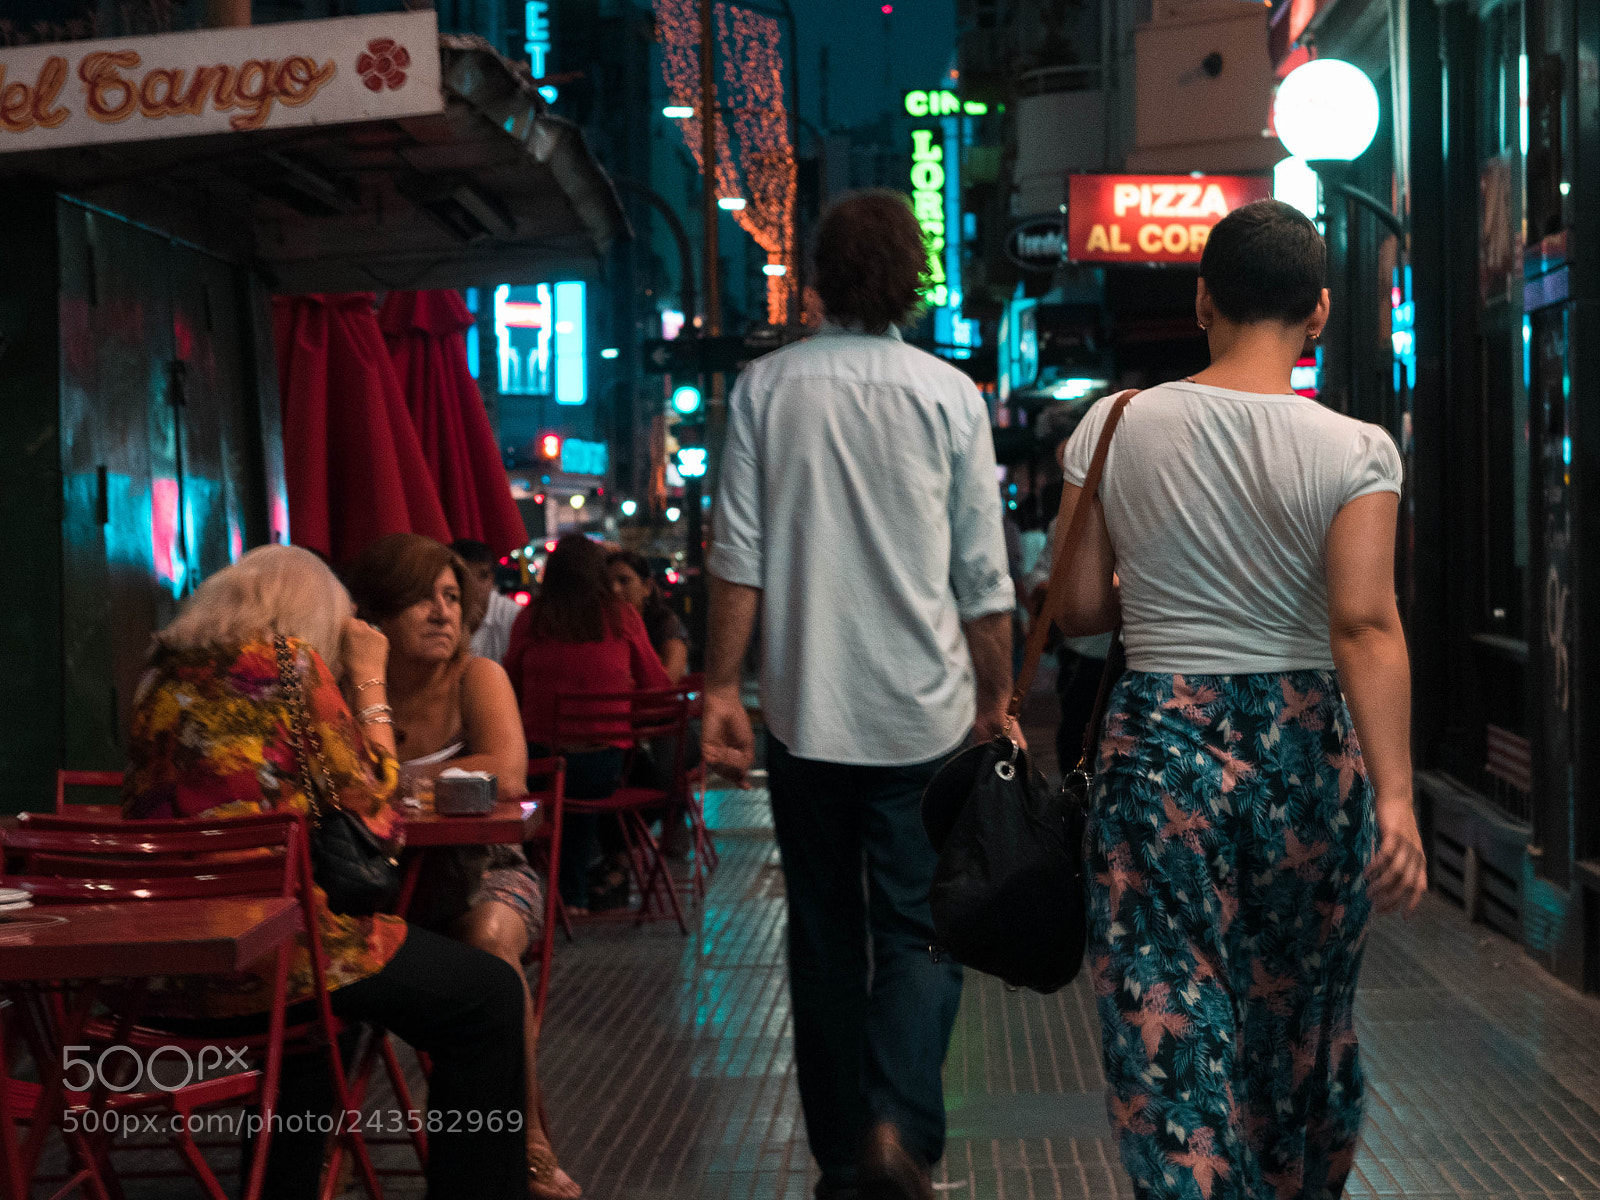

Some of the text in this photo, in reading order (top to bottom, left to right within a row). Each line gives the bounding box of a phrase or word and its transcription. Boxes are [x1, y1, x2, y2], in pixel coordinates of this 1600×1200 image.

[0, 51, 336, 132] el Tango
[1113, 184, 1229, 217] PIZZA
[1086, 224, 1132, 253] AL
